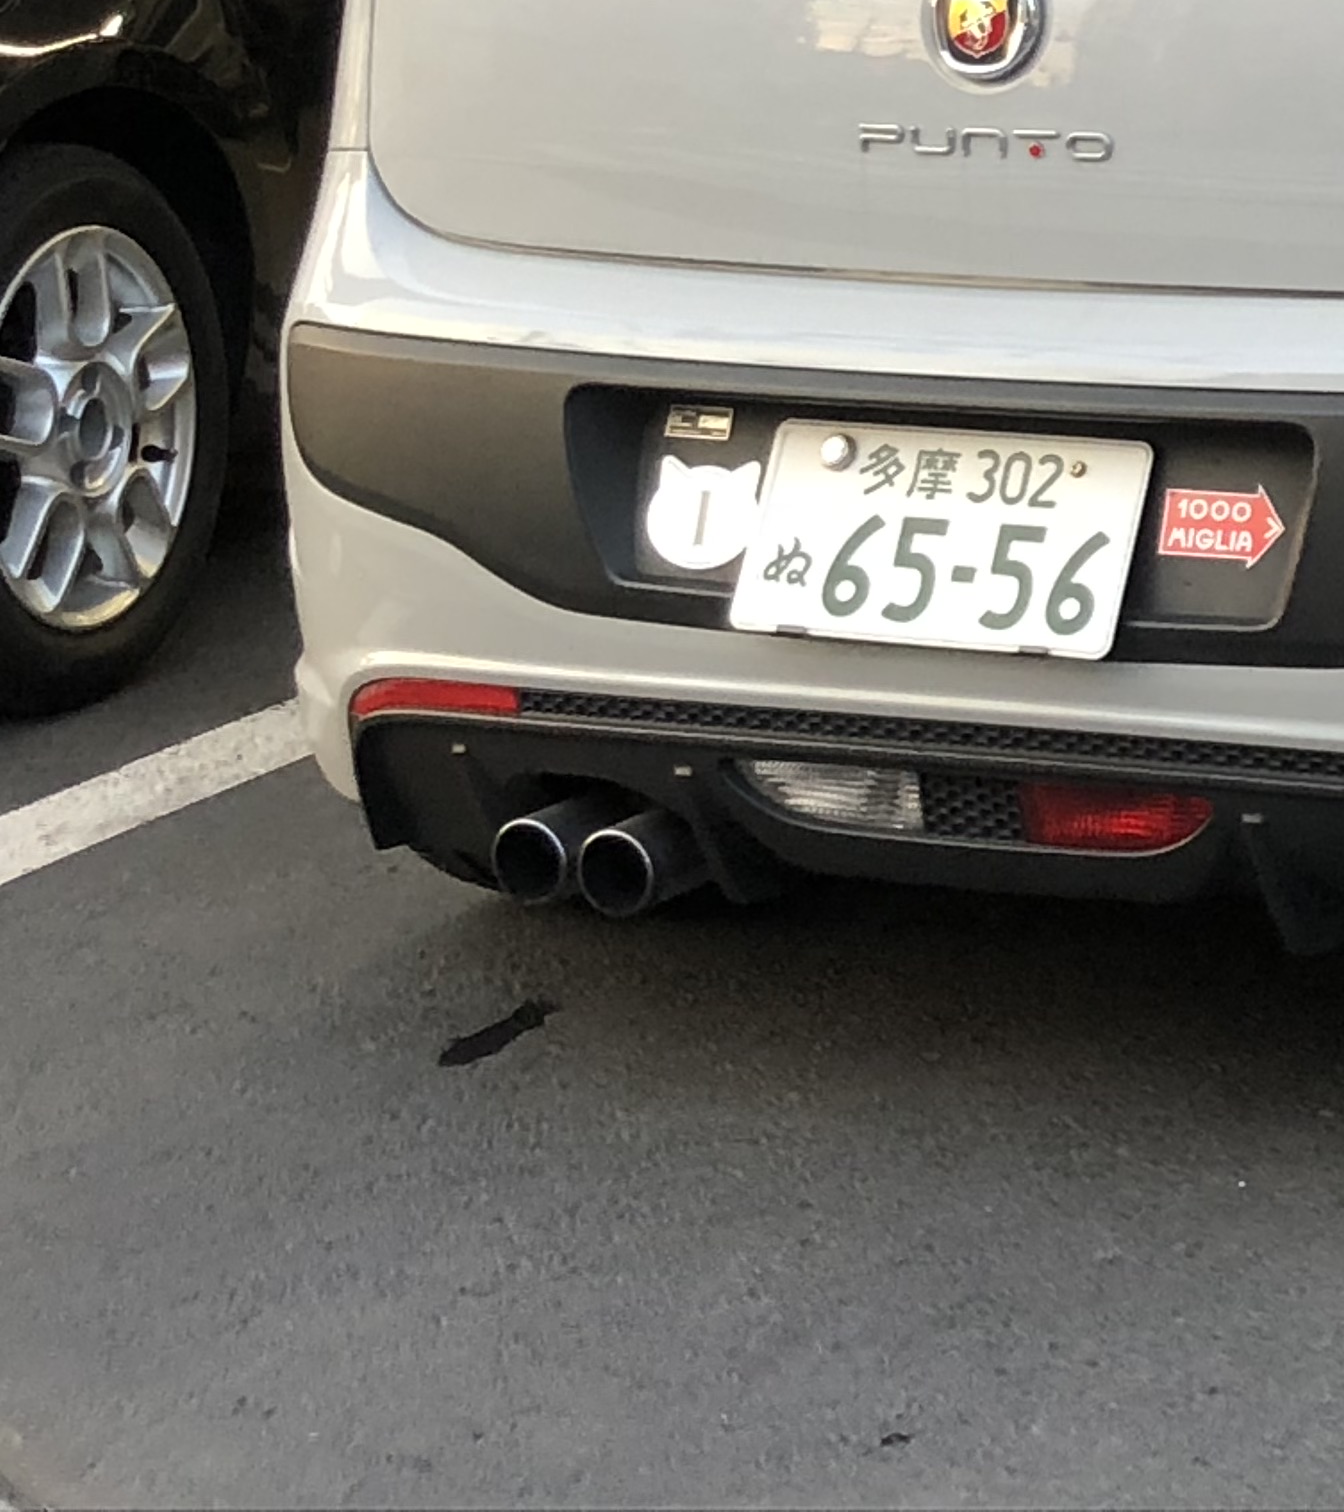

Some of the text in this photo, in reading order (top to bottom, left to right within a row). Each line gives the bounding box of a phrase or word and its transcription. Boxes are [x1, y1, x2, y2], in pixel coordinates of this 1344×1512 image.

[858, 123, 1115, 162] PUNTO
[859, 443, 1065, 509] 多摩 302
[1177, 498, 1252, 523] 1000
[1166, 527, 1253, 552] MIGLIA
[763, 514, 1112, 636] ぬ 65-56
